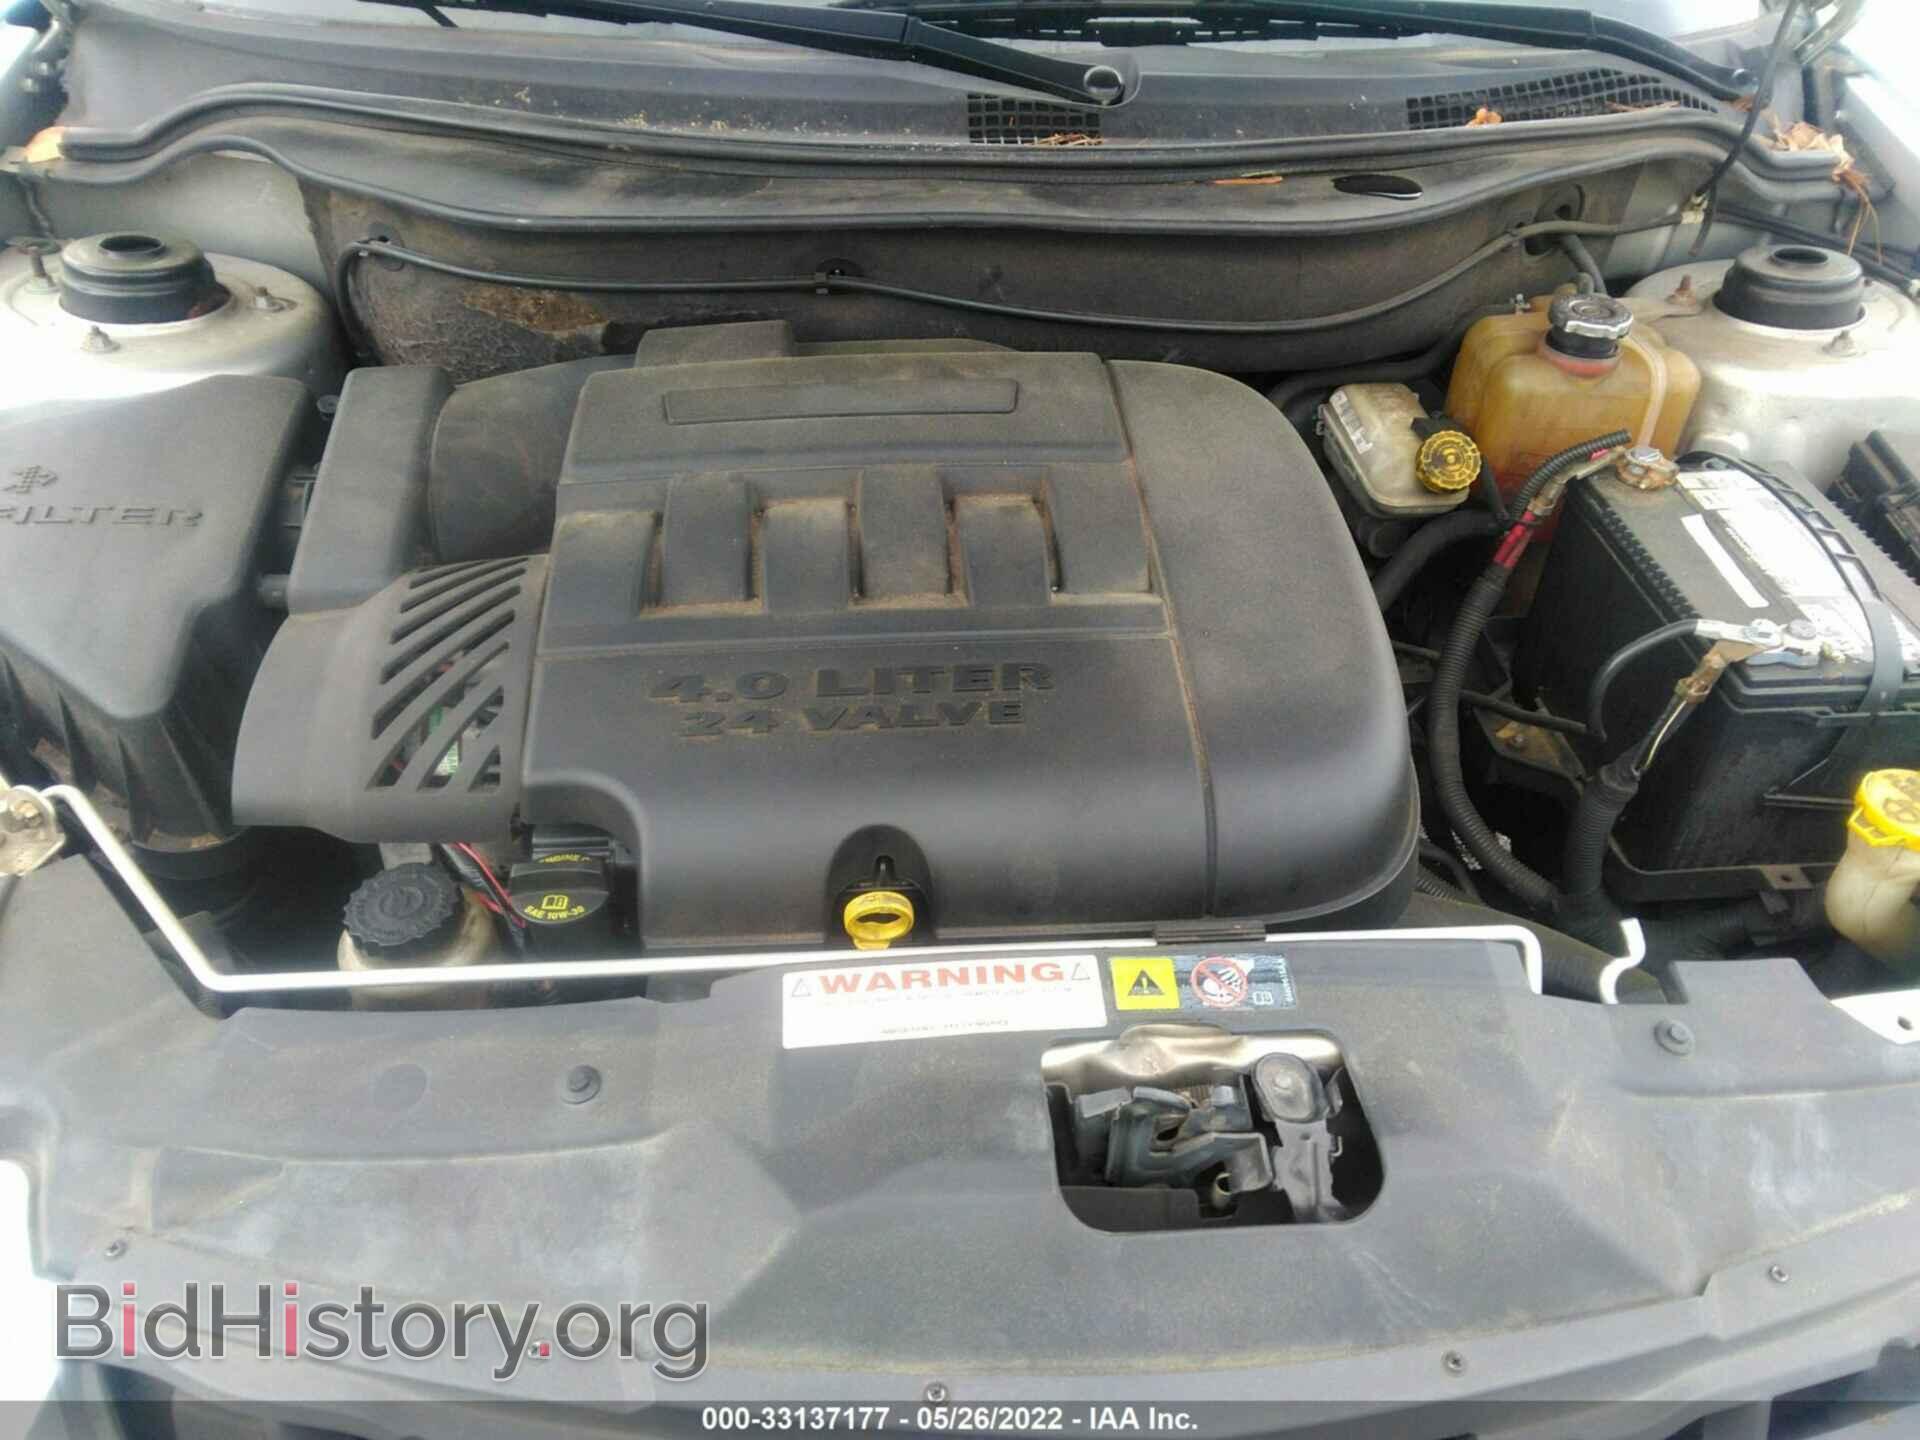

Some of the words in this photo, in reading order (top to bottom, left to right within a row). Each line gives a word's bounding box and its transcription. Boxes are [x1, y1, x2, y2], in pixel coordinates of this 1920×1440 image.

[649, 671, 789, 703] 4.0
[815, 662, 1055, 698] LITER
[681, 709, 780, 739] 24
[802, 700, 1026, 732] VALVE
[819, 962, 1064, 995] WARNING
